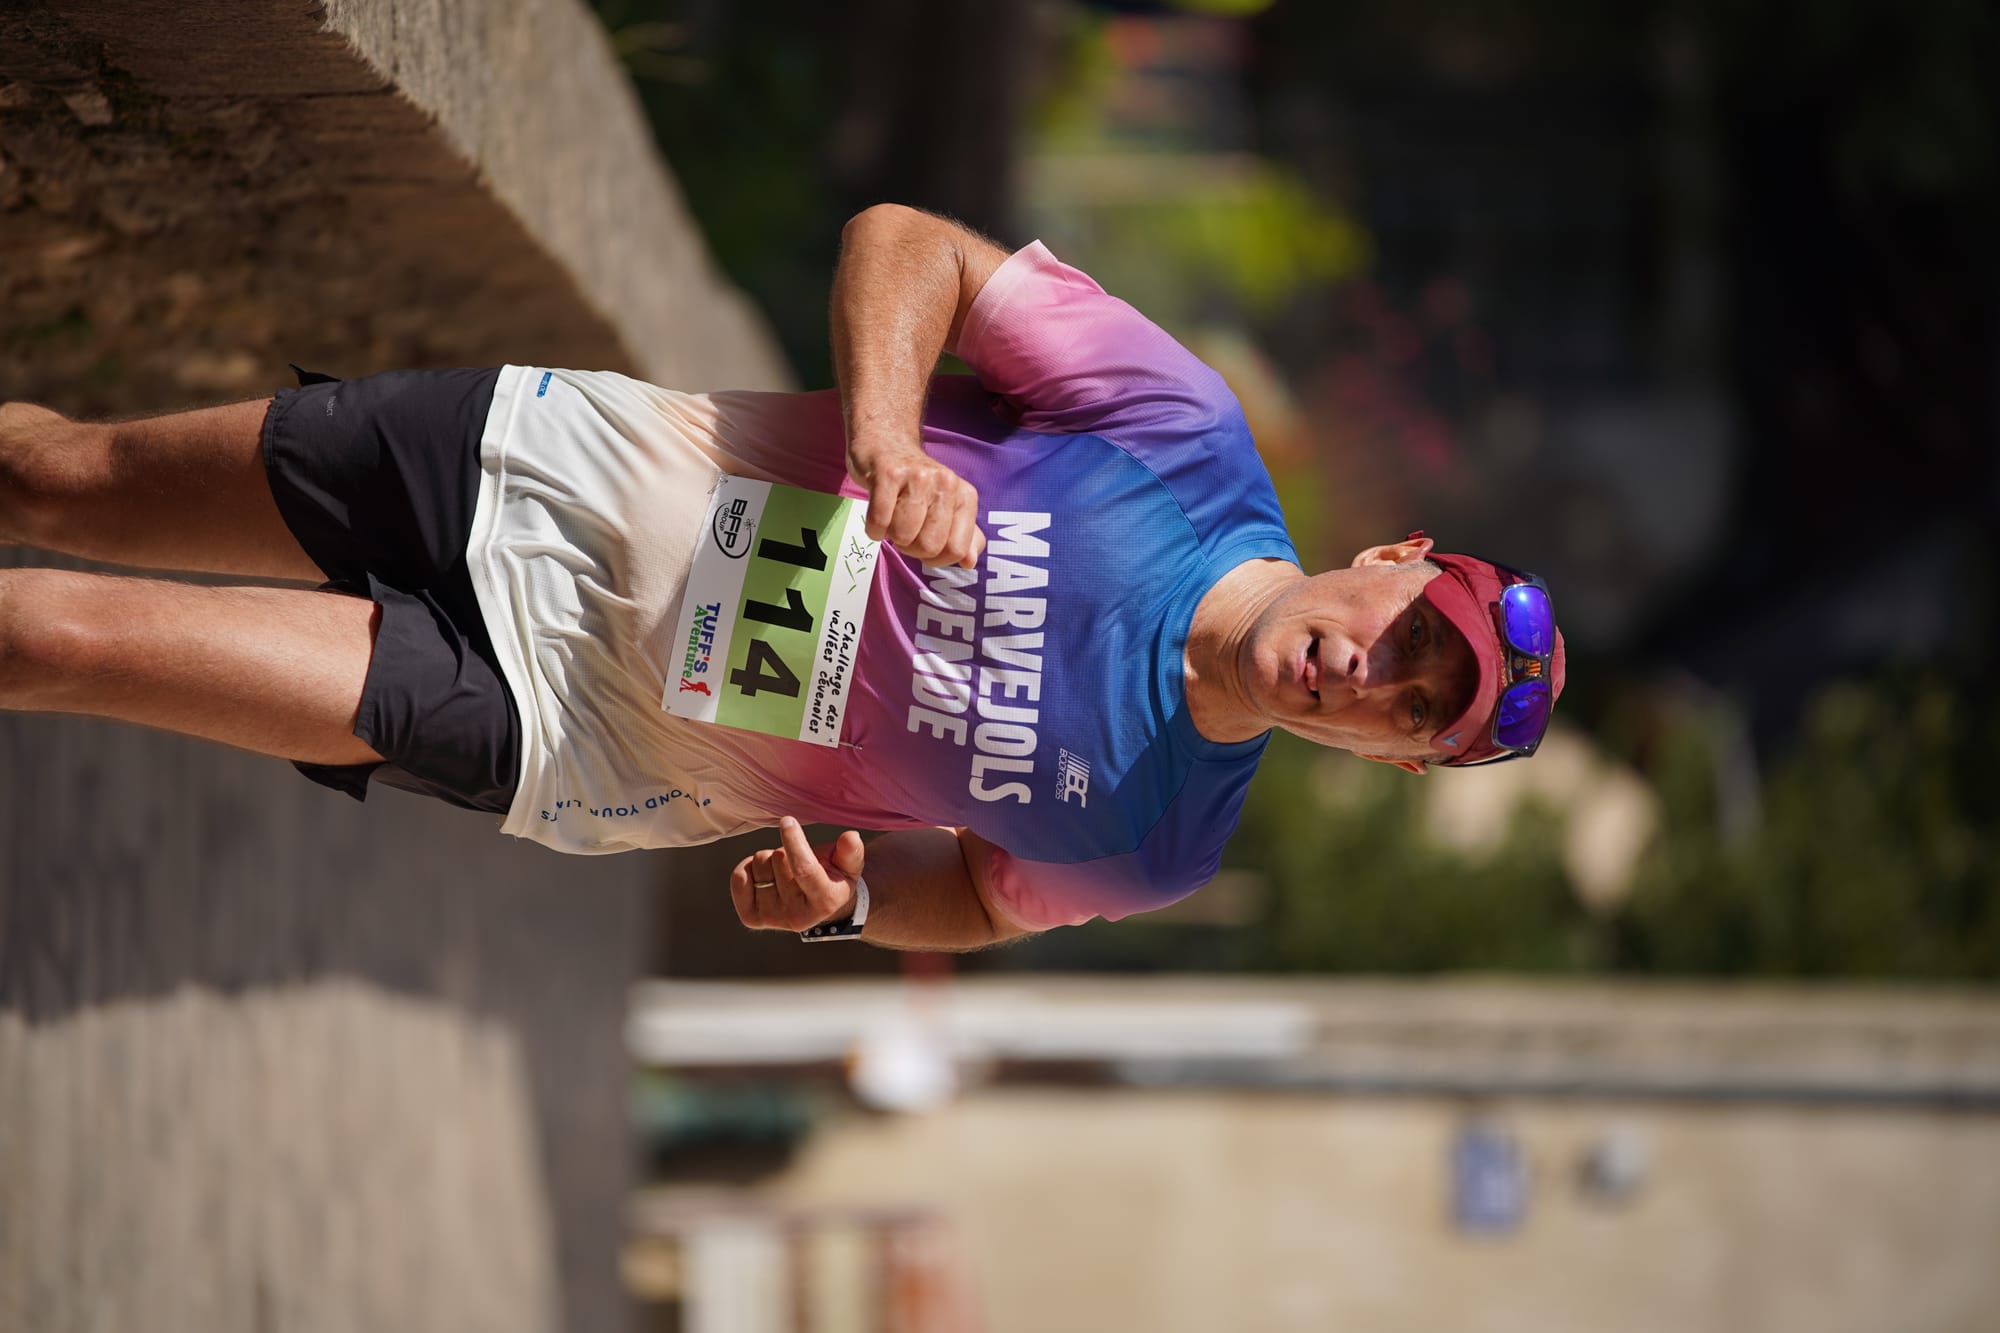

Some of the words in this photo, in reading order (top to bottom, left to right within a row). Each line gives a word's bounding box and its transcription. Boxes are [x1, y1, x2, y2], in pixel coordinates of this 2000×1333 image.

[718, 507, 730, 532] GROUP
[722, 499, 748, 549] BFP
[682, 604, 709, 679] Aventure
[693, 602, 721, 673] TUFF'S
[729, 528, 828, 698] 114
[823, 610, 842, 664] vallées
[829, 621, 856, 697] Challenge
[907, 560, 978, 746] MENDE
[969, 511, 1052, 804] MARVEJOLS
[809, 671, 835, 734] cévenoles
[824, 705, 838, 730] des
